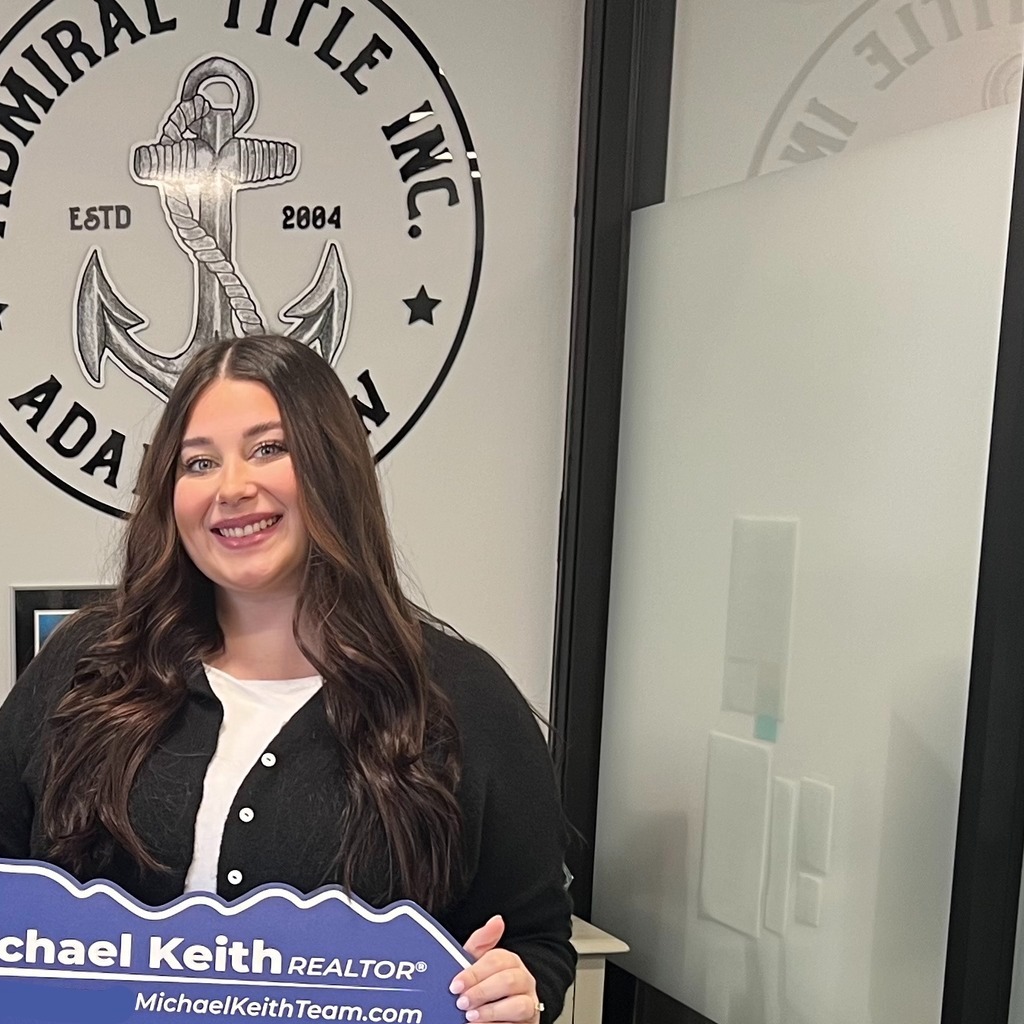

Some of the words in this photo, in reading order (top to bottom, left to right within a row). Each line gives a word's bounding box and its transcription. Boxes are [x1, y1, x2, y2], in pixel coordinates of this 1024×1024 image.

[381, 100, 460, 238] INC.
[69, 205, 131, 230] ESTD
[282, 205, 341, 230] 2004
[149, 935, 282, 975] Keith
[134, 992, 423, 1024] MichaelKeithTeam.com
